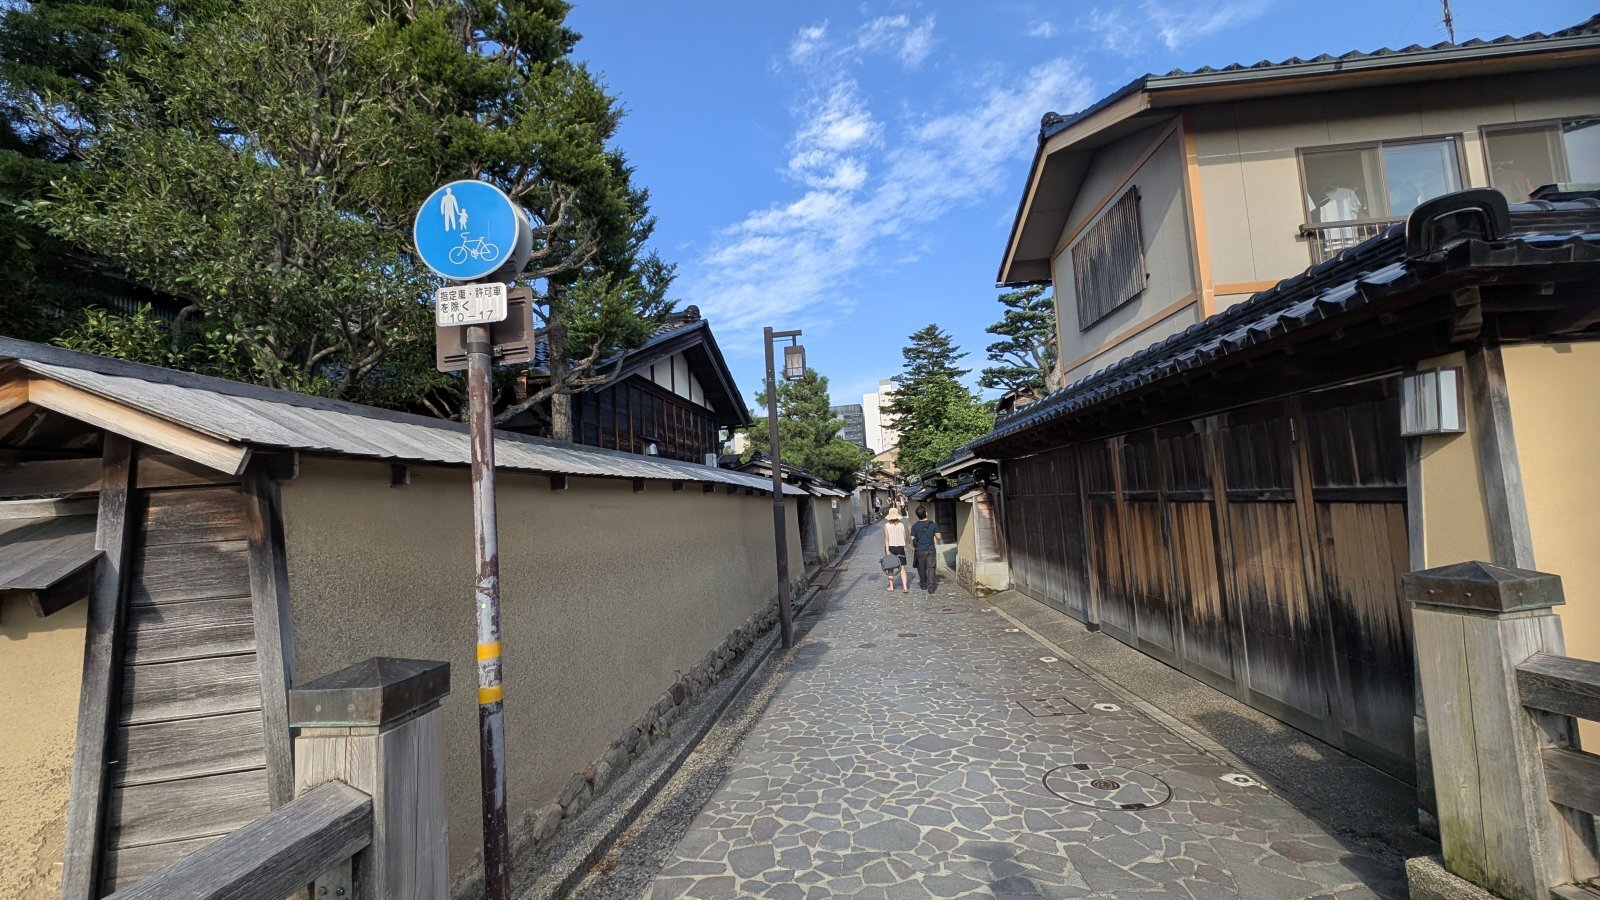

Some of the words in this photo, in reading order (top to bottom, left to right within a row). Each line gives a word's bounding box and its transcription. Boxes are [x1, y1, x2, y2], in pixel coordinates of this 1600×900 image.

[440, 286, 501, 302] 指定車・許可車
[440, 300, 469, 313] を除く
